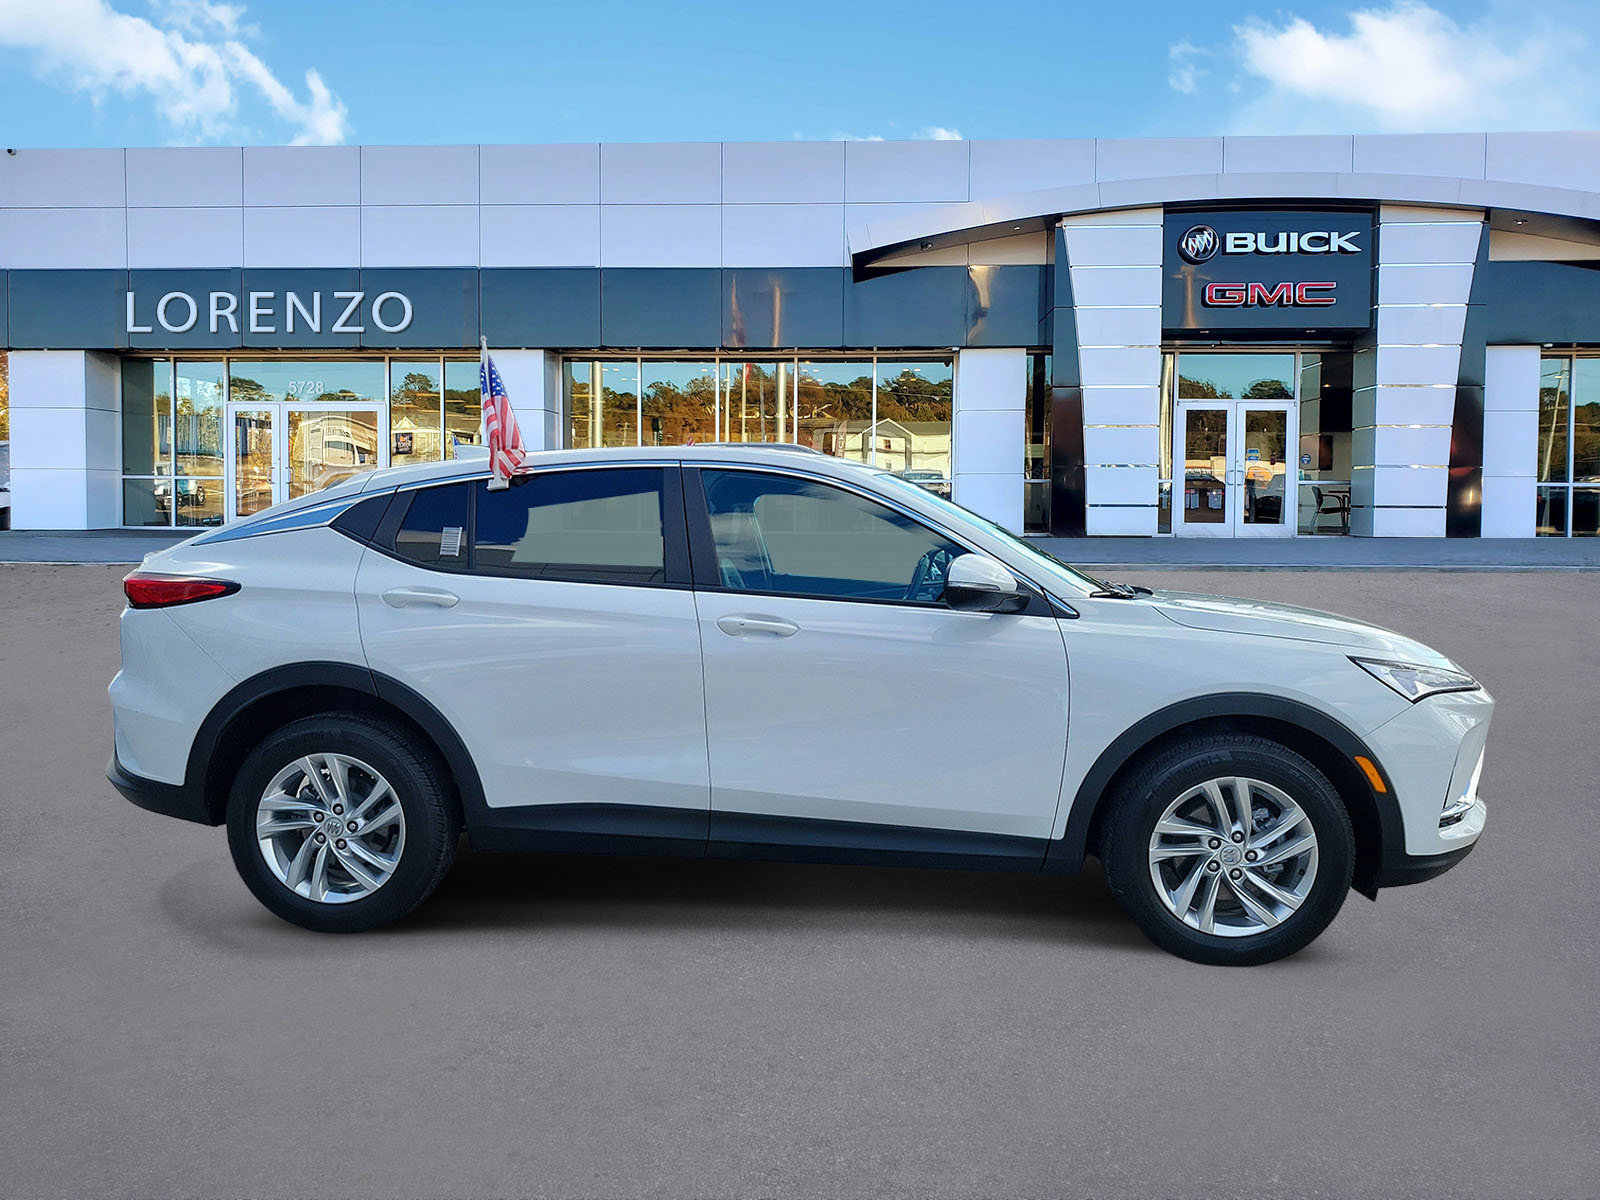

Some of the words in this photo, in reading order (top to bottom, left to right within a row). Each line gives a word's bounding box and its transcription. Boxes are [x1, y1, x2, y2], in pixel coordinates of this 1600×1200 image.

[1226, 231, 1362, 253] BUICK
[1205, 282, 1337, 305] GMC
[126, 291, 413, 333] LORENZO
[288, 381, 325, 394] 5728
